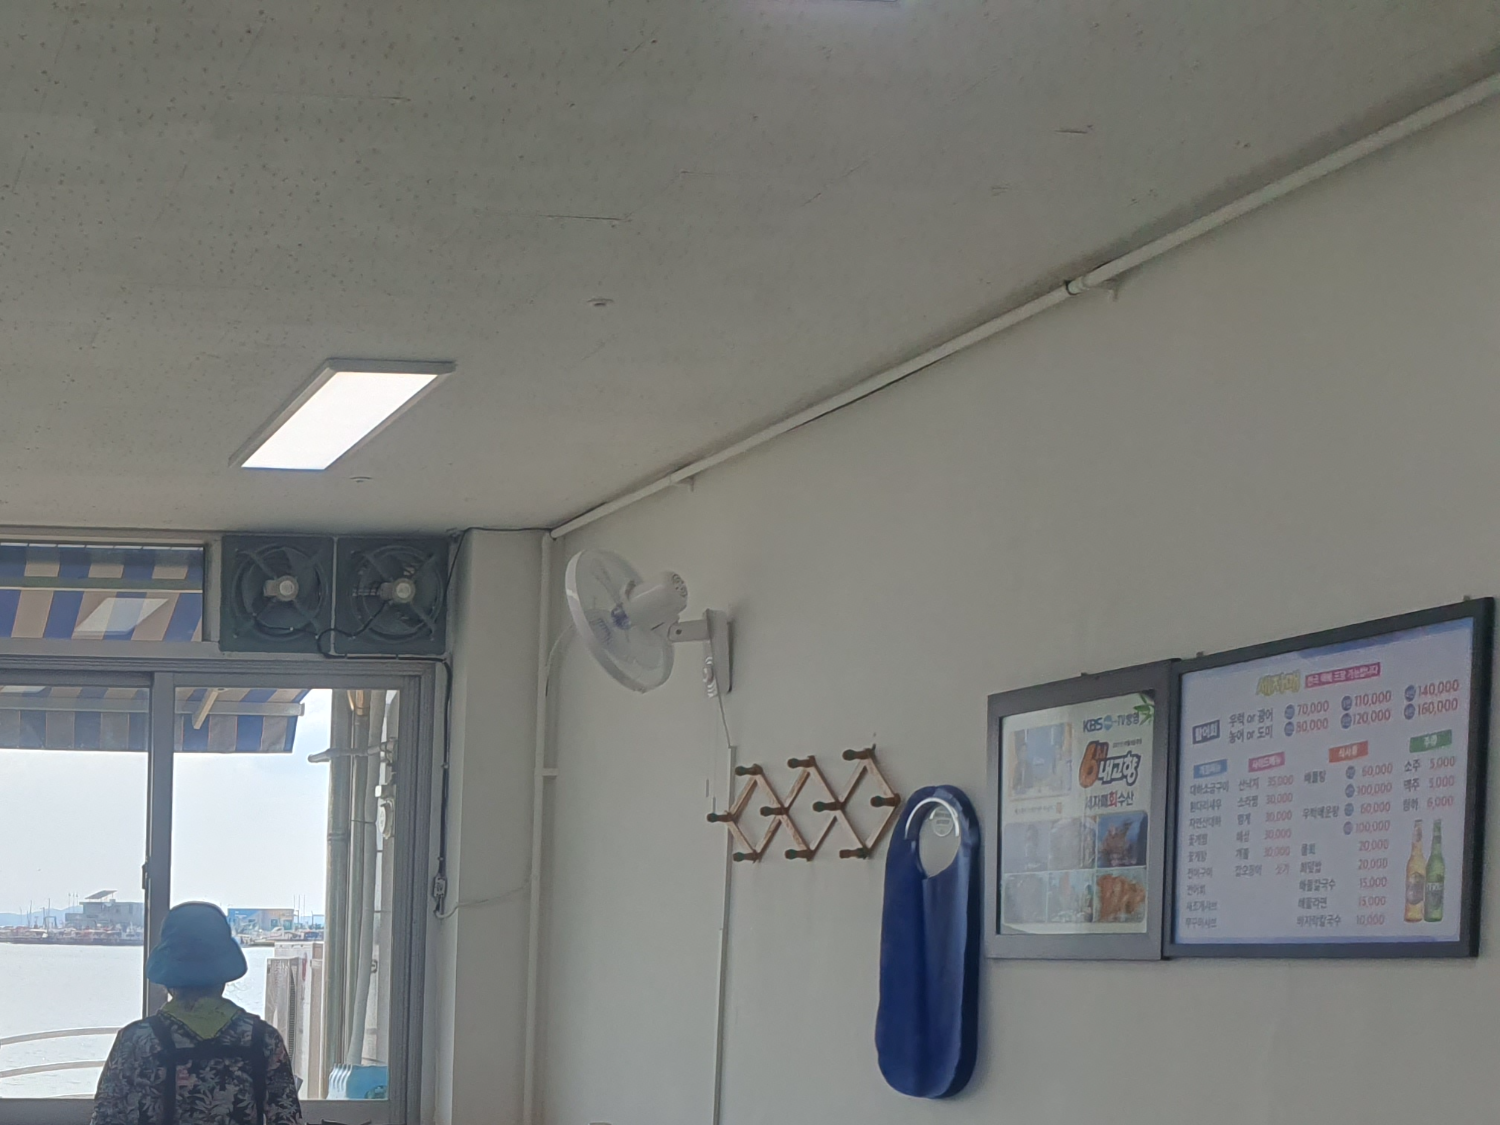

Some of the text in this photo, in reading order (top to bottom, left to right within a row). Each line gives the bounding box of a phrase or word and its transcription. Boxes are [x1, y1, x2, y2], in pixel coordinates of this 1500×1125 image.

[1418, 679, 1460, 698] 140,000
[1354, 690, 1392, 707] 110,000
[1417, 697, 1459, 716] 160,000
[1297, 700, 1330, 717] 70,000
[1352, 708, 1392, 726] 120,000
[1083, 717, 1103, 733] KBS
[1228, 712, 1245, 728] 우럭
[1246, 714, 1256, 724] or
[1256, 708, 1274, 724] 광어
[1246, 730, 1256, 740] or
[1256, 725, 1274, 740] 도미
[1099, 750, 1142, 787] 내고향
[1361, 762, 1394, 777] 60,000
[1404, 756, 1456, 772] 소주 5,000
[1403, 778, 1420, 792] 맥주
[1426, 795, 1455, 809] 6,000
